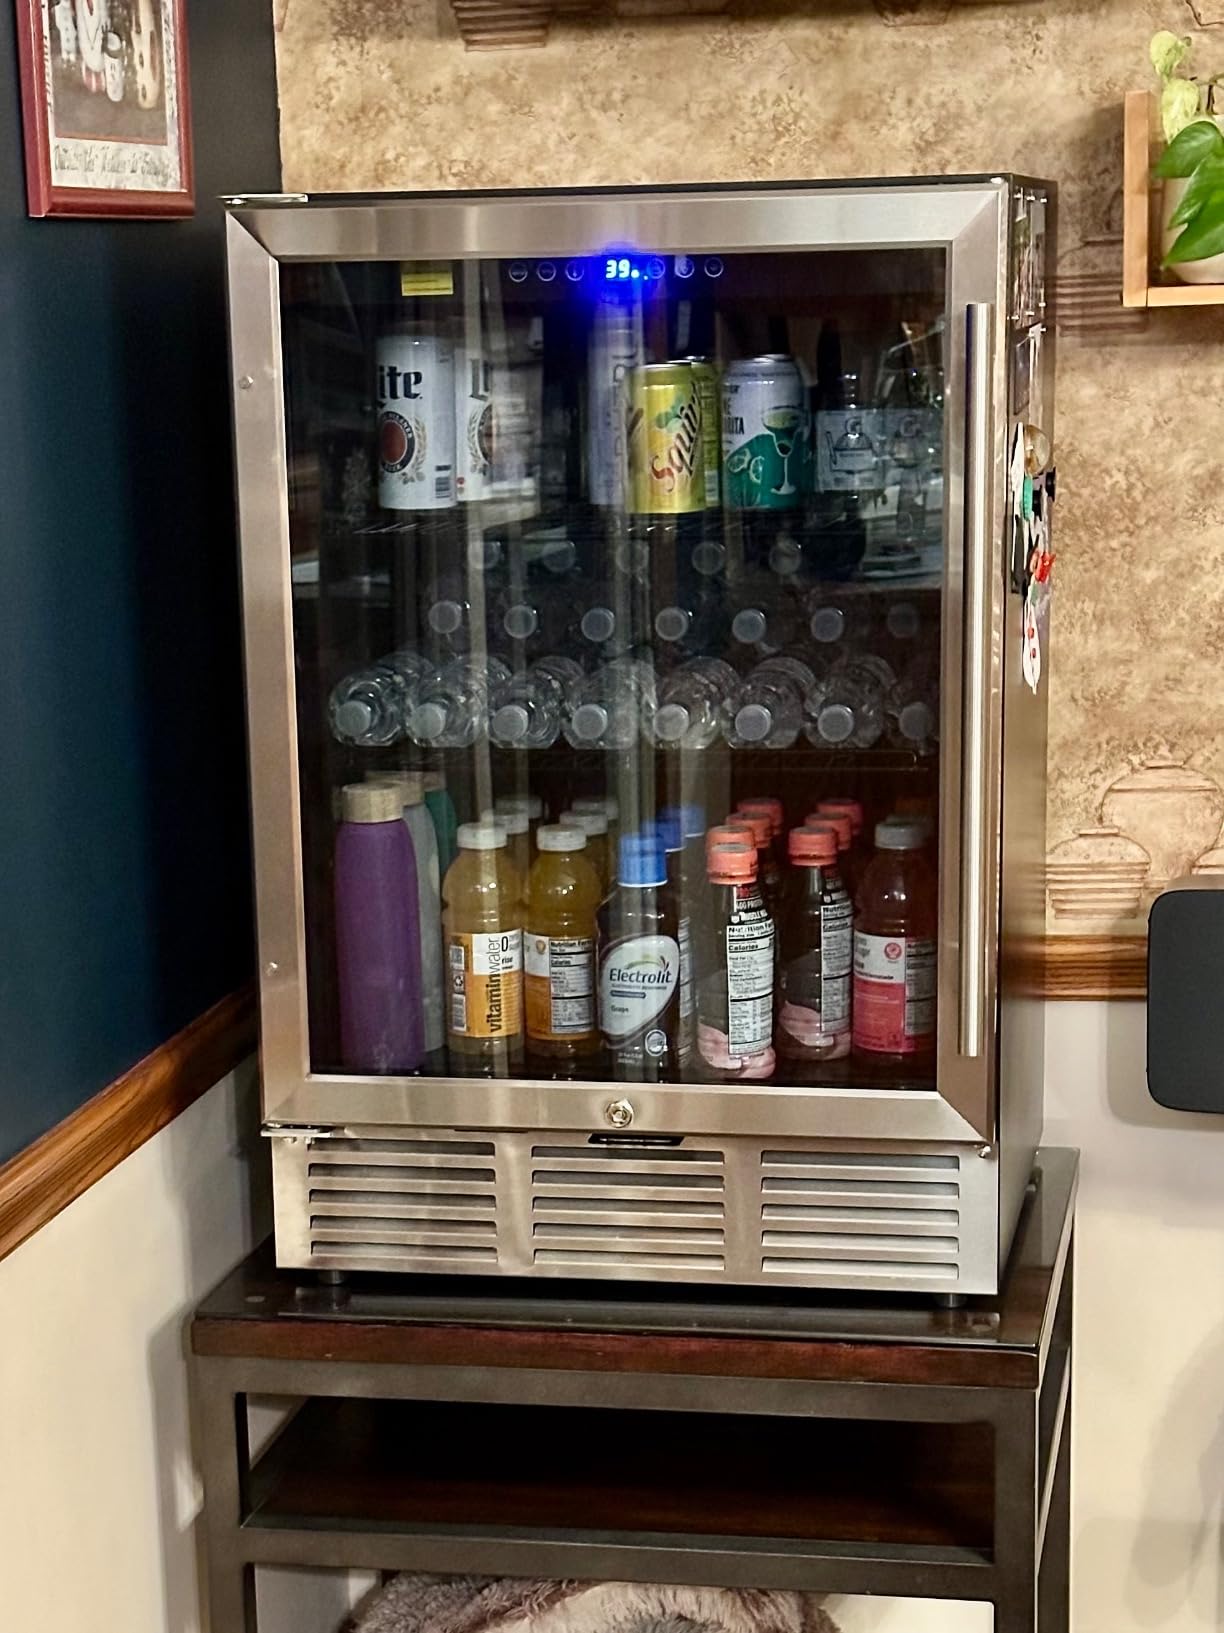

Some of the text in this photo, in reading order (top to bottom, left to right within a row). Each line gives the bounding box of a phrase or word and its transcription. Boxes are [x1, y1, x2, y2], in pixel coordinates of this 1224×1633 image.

[501, 936, 509, 952] 0
[609, 968, 672, 984] Electrolit
[485, 936, 502, 1033] vitaminwater
